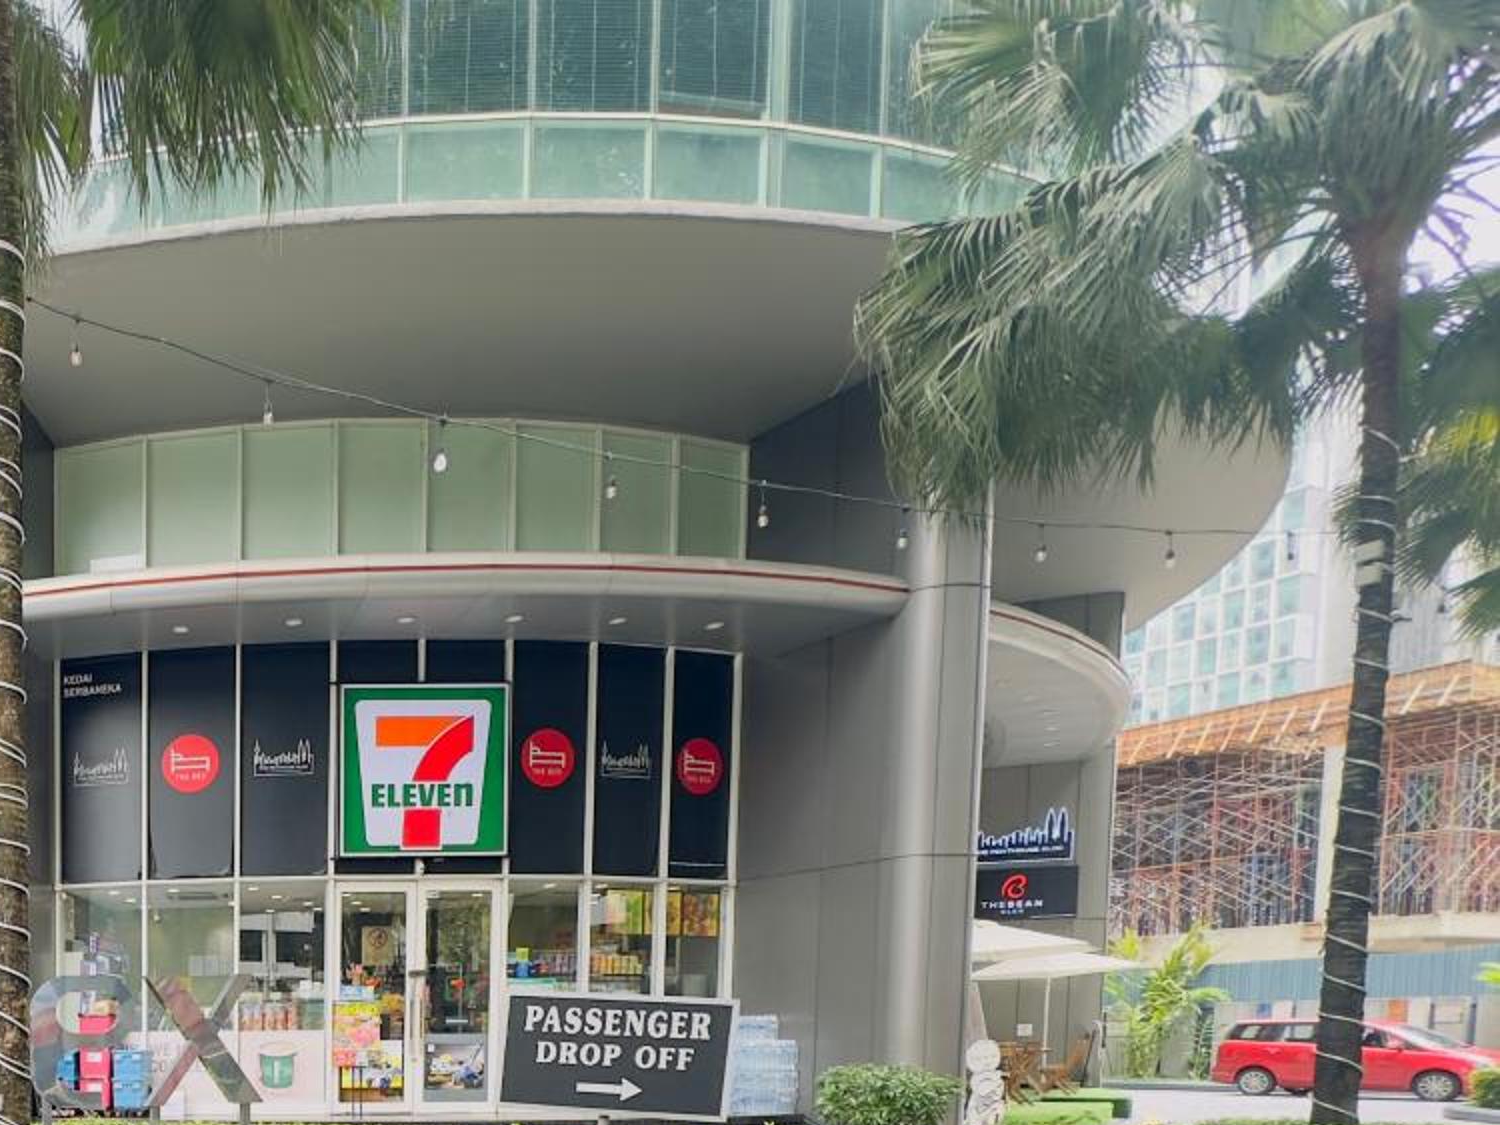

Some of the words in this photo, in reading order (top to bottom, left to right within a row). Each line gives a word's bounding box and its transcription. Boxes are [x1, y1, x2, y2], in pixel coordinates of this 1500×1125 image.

[375, 715, 475, 848] 7
[524, 1005, 711, 1040] PASSENGER
[536, 1041, 622, 1066] DROP
[635, 1046, 695, 1071] OFF
